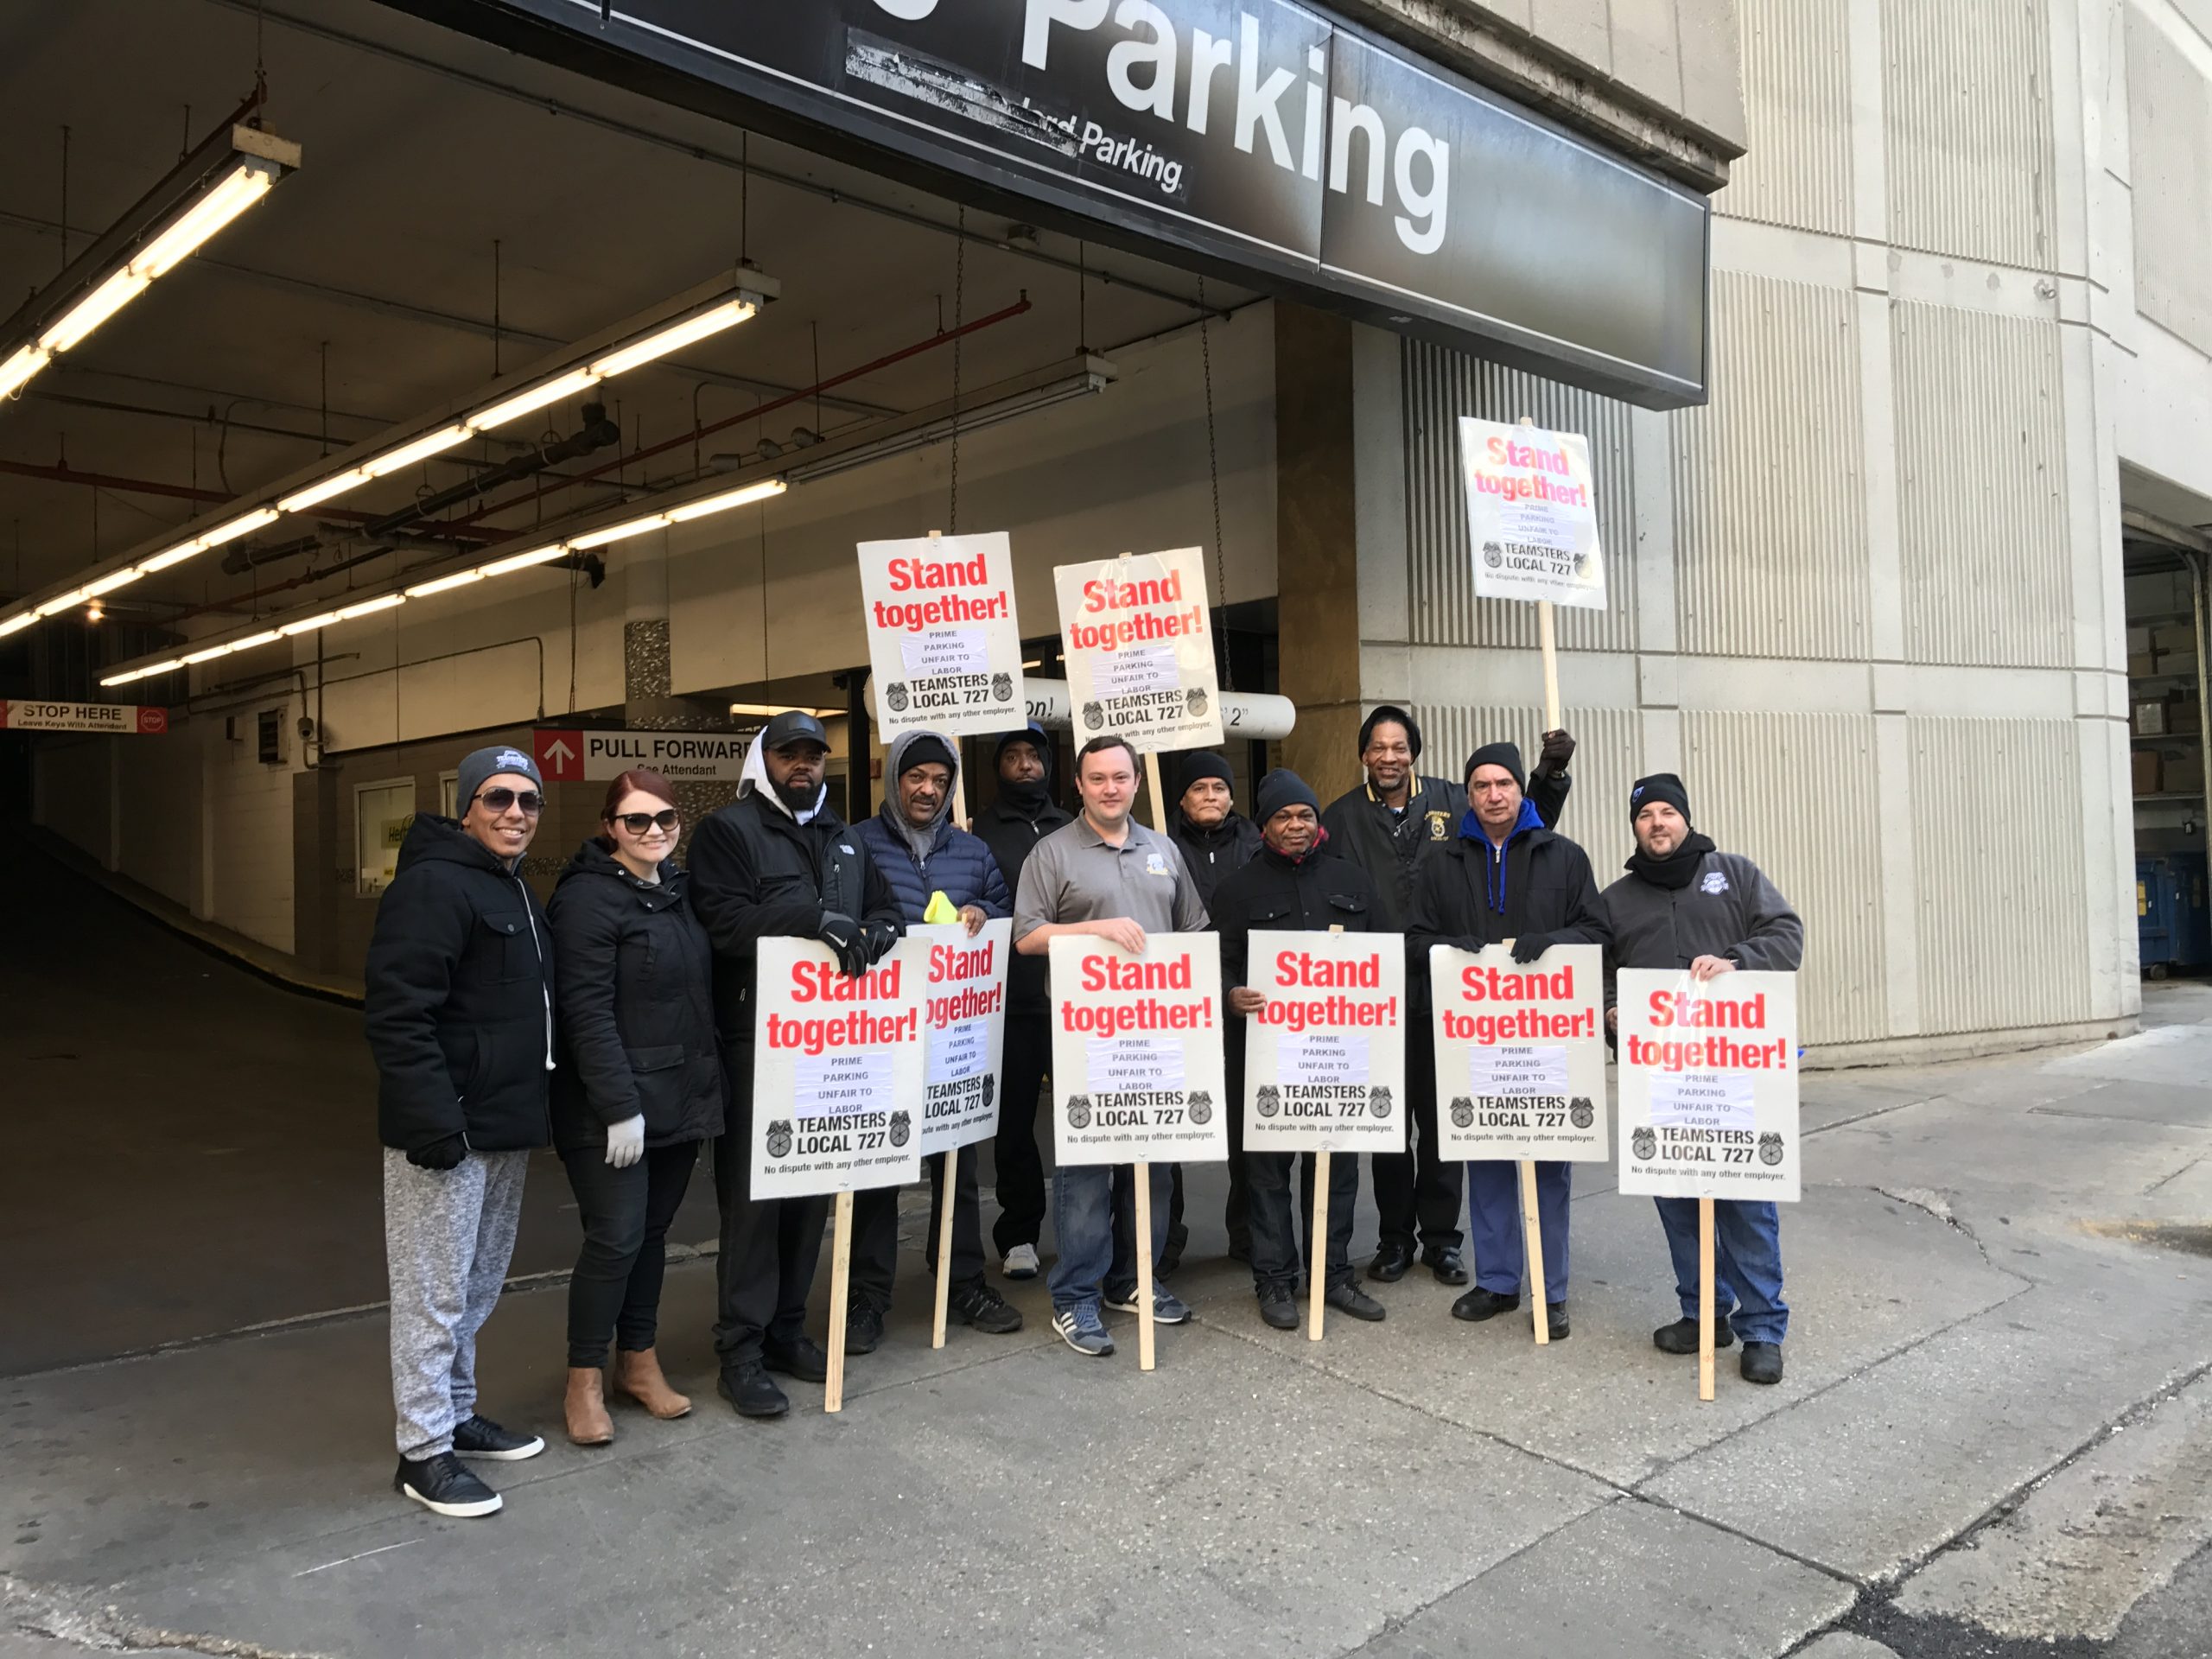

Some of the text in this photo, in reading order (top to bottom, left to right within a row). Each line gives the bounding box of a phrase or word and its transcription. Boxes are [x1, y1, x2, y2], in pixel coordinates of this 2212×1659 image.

[1486, 436, 1569, 475] Stand
[1475, 469, 1587, 507] together!
[1505, 543, 1570, 561] TEAMSTERS
[888, 553, 988, 592] Stand
[1506, 557, 1571, 575] LOCAL 727
[1084, 569, 1181, 613] Stand
[874, 591, 1008, 632] together!
[1070, 606, 1203, 652] together!
[924, 642, 965, 652] PARKING
[1118, 650, 1146, 658] PRIME
[921, 655, 955, 664] UNFAIR
[1114, 661, 1154, 671] PARKING
[911, 674, 988, 692] TEAMSTERS
[1111, 674, 1143, 684] UNFAIR
[1122, 685, 1151, 695] LABOR
[913, 690, 988, 709] LOCAL 727
[1105, 690, 1182, 710] TEAMSTERS
[24, 705, 122, 721] STOP HERE
[901, 713, 928, 723] dispute
[982, 706, 1016, 715] employer.
[1108, 706, 1184, 726] LOCAL 727
[1142, 728, 1154, 737] any
[1178, 721, 1212, 731] employer.
[590, 739, 752, 759] PULL FORWAR
[663, 764, 716, 775] Attendant
[929, 940, 994, 982] Stand
[1275, 950, 1379, 988] Stand
[791, 959, 901, 1002] Stand
[1081, 953, 1192, 991] Stand
[1461, 965, 1573, 1001] Stand
[926, 982, 1001, 1029] ogether!
[1649, 990, 1765, 1029] Stand
[1061, 996, 1212, 1038] together!
[766, 1007, 918, 1056] together!
[954, 1024, 971, 1033] PRIME
[1442, 1007, 1595, 1045] together!
[949, 1037, 975, 1049] PARKING
[1119, 1039, 1150, 1048] PRIME
[831, 1057, 862, 1065] PRIME
[945, 1053, 968, 1065] UNFAIR
[1112, 1053, 1158, 1062] PARKING
[1627, 1034, 1786, 1072] together!
[823, 1071, 869, 1082] PARKING
[951, 1066, 969, 1077] LABOR
[1308, 1075, 1340, 1084] LABOR
[818, 1088, 872, 1099] UNFAIR TO
[927, 1076, 980, 1099] TEAMSTERS
[1284, 1085, 1365, 1099] TEAMSTERS
[1678, 1089, 1726, 1097] PARKING
[925, 1094, 980, 1119] LOCAL 727
[1095, 1091, 1184, 1108] TEAMSTERS
[1478, 1096, 1566, 1109] TEAMSTERS
[1674, 1103, 1713, 1112] UNFAIR
[829, 1104, 862, 1115] LABOR
[1096, 1109, 1184, 1127] LOCAL 727
[1284, 1103, 1365, 1116] LOCAL 727
[797, 1112, 887, 1133] TEAMSTERS
[1268, 1123, 1297, 1132] dispute
[1319, 1124, 1332, 1133] any
[1335, 1123, 1354, 1132] other
[1478, 1112, 1566, 1127] LOCAL 727
[1685, 1117, 1720, 1126] LABOR
[797, 1132, 886, 1154] LOCAL 727
[1081, 1135, 1111, 1143] dispute
[1135, 1133, 1148, 1142] any
[1175, 1131, 1216, 1141] employer.
[1464, 1133, 1494, 1141] dispute
[1516, 1134, 1531, 1142] any
[1662, 1128, 1754, 1144] TEAMSTERS
[1662, 1145, 1754, 1163] LOCAL 727
[764, 1153, 910, 1174] No dispute with any other employer.
[1645, 1167, 1676, 1176] dispute
[1700, 1169, 1717, 1179] any
[1719, 1170, 1742, 1179] other
[1745, 1172, 1786, 1180] employer.
